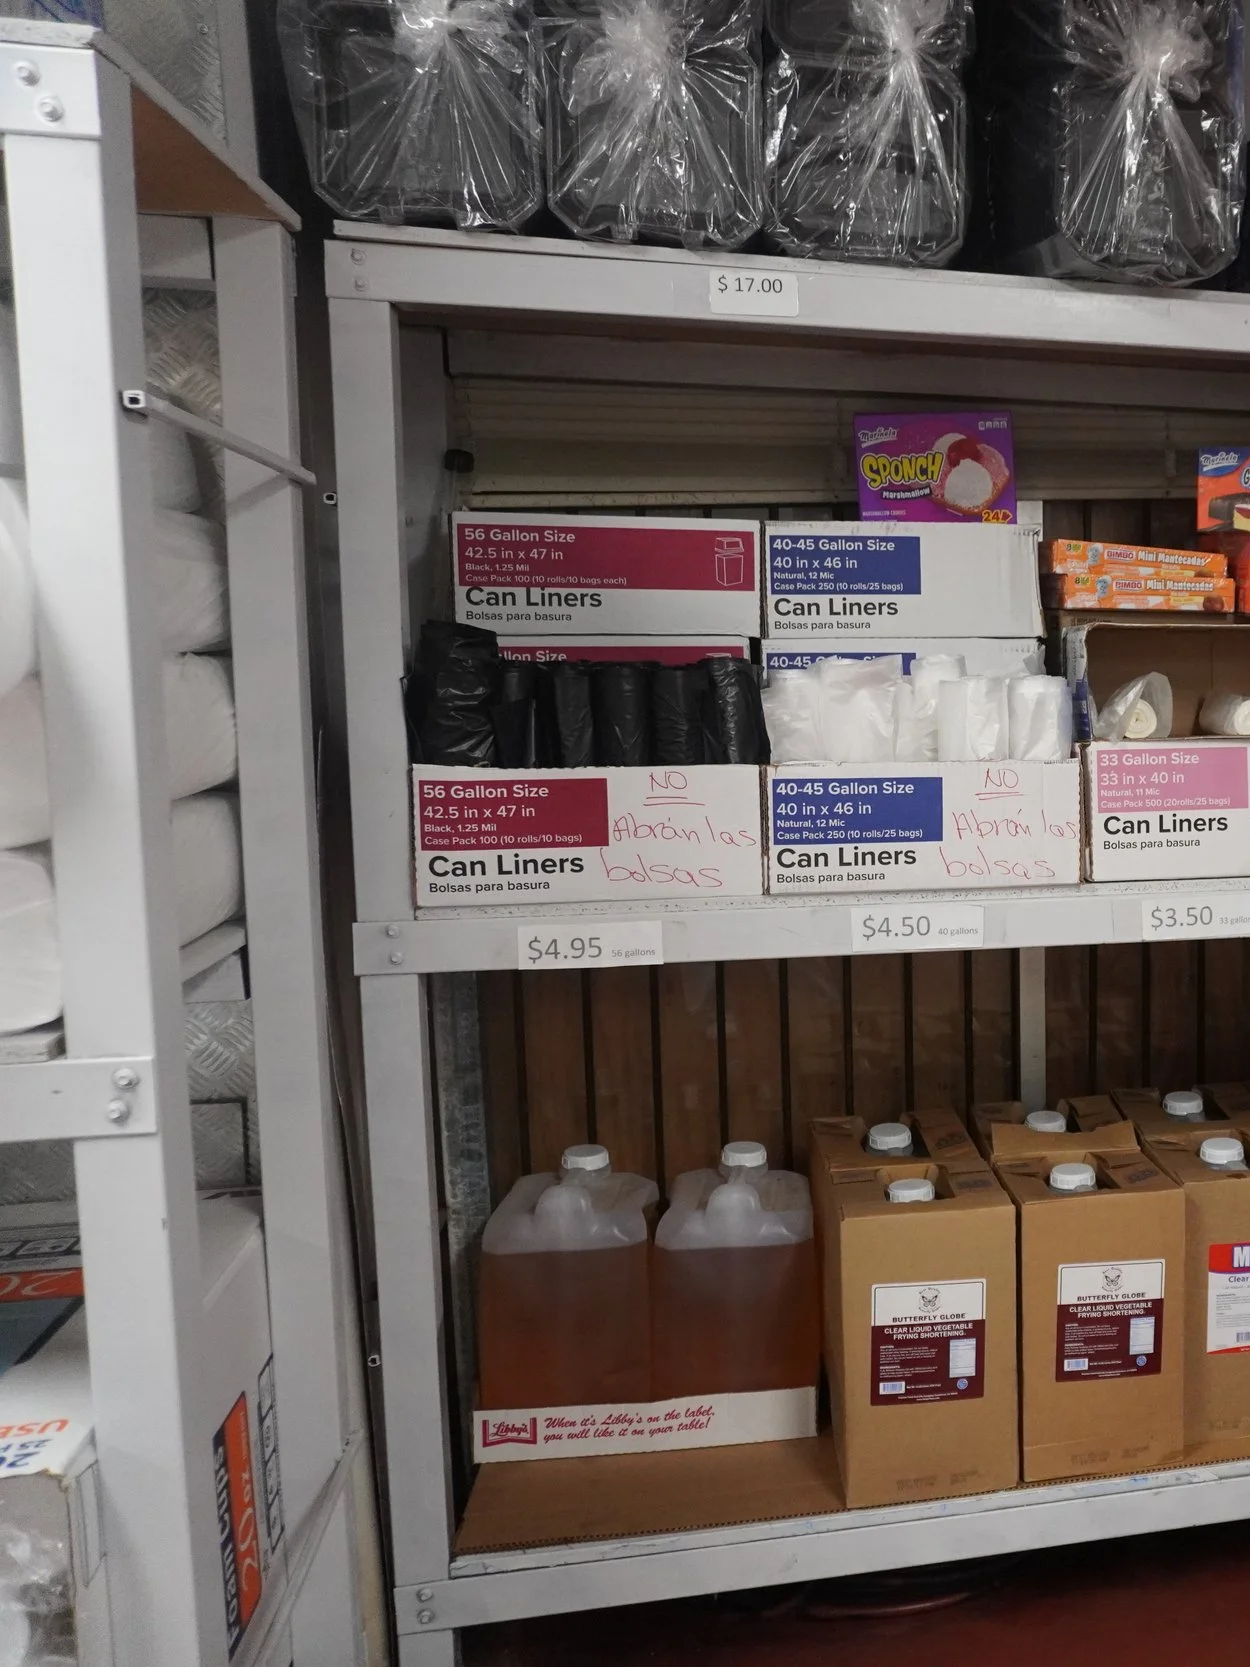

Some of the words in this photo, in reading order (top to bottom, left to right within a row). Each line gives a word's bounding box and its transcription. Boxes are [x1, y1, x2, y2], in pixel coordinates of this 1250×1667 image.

[719, 275, 727, 293] $
[735, 278, 782, 293] 17.00
[863, 452, 943, 487] SPONCH
[883, 487, 930, 499] Marshmallow
[465, 529, 485, 540] 56
[490, 530, 539, 542] Gallon
[544, 530, 575, 543] Size
[773, 540, 814, 550] 40-45
[819, 540, 862, 551] Gallon
[867, 540, 895, 551] Size
[465, 548, 497, 559] 42.5
[501, 547, 513, 559] in
[518, 550, 526, 559] x
[530, 549, 547, 560] 47
[552, 549, 563, 560] in
[466, 587, 516, 607] Can
[526, 587, 602, 608] Liners
[774, 599, 820, 616] Can
[829, 598, 898, 615] Liners
[1100, 754, 1118, 766] 33
[1123, 754, 1167, 766] Gallon
[1171, 753, 1199, 765] Size
[650, 771, 687, 790] NO
[985, 768, 1018, 789] NO
[1100, 773, 1118, 785] 33
[1123, 773, 1135, 784] in
[1139, 776, 1147, 784] x
[1151, 772, 1168, 784] 40
[1172, 772, 1184, 784] in
[424, 785, 445, 798] 56
[451, 786, 506, 799] Gallon
[513, 785, 549, 797] Size
[777, 783, 823, 795] 40-45
[828, 783, 877, 795] Gallon
[882, 782, 914, 794] Size
[424, 806, 459, 818] 42.5
[464, 806, 478, 818] in
[483, 809, 492, 818] x
[497, 805, 516, 817] 47
[521, 805, 535, 817] in
[777, 803, 797, 815] 40
[802, 803, 816, 815] in
[821, 806, 829, 815] x
[834, 802, 853, 814] 46
[859, 802, 871, 814] in
[425, 824, 454, 834] Black,
[457, 824, 478, 832] 1.25
[777, 820, 813, 829] Natural,
[829, 819, 845, 827] Mic
[1104, 816, 1150, 835] Can
[1159, 813, 1228, 833] Liners
[425, 836, 450, 845] Case
[453, 836, 477, 845] Pack
[479, 836, 498, 844] 100
[500, 835, 514, 845] (10
[516, 834, 553, 844] rolls/10
[555, 833, 582, 844] bags)
[1103, 839, 1137, 850] Bolsas
[1140, 840, 1163, 850] para
[1166, 838, 1200, 847] basura
[777, 848, 829, 868] Can
[839, 846, 916, 866] Liners
[429, 856, 486, 878] Can
[497, 854, 584, 876] Liners
[777, 873, 815, 883] Bolsas
[818, 874, 843, 884] para
[847, 871, 885, 881] basura
[429, 881, 471, 893] Bolsas
[476, 882, 504, 893] para
[508, 880, 550, 890] basura
[1151, 906, 1213, 930] $3.50
[863, 915, 930, 941] $4.50
[938, 927, 948, 935] 40
[950, 927, 978, 936] gallons
[528, 937, 602, 964] $4.95
[611, 949, 623, 957] 56
[625, 948, 655, 959] gallons
[1229, 1275, 1249, 1283] Clear
[934, 1323, 973, 1331] VEGETABLE
[544, 1418, 576, 1428] When
[581, 1415, 596, 1427] it's
[601, 1413, 642, 1427] Libby's
[664, 1410, 680, 1421] the
[544, 1433, 562, 1443] you
[568, 1428, 588, 1440] will
[593, 1426, 616, 1438] like
[619, 1427, 628, 1437] it
[631, 1428, 644, 1436] on
[649, 1426, 672, 1438] your
[677, 1418, 710, 1431] table!
